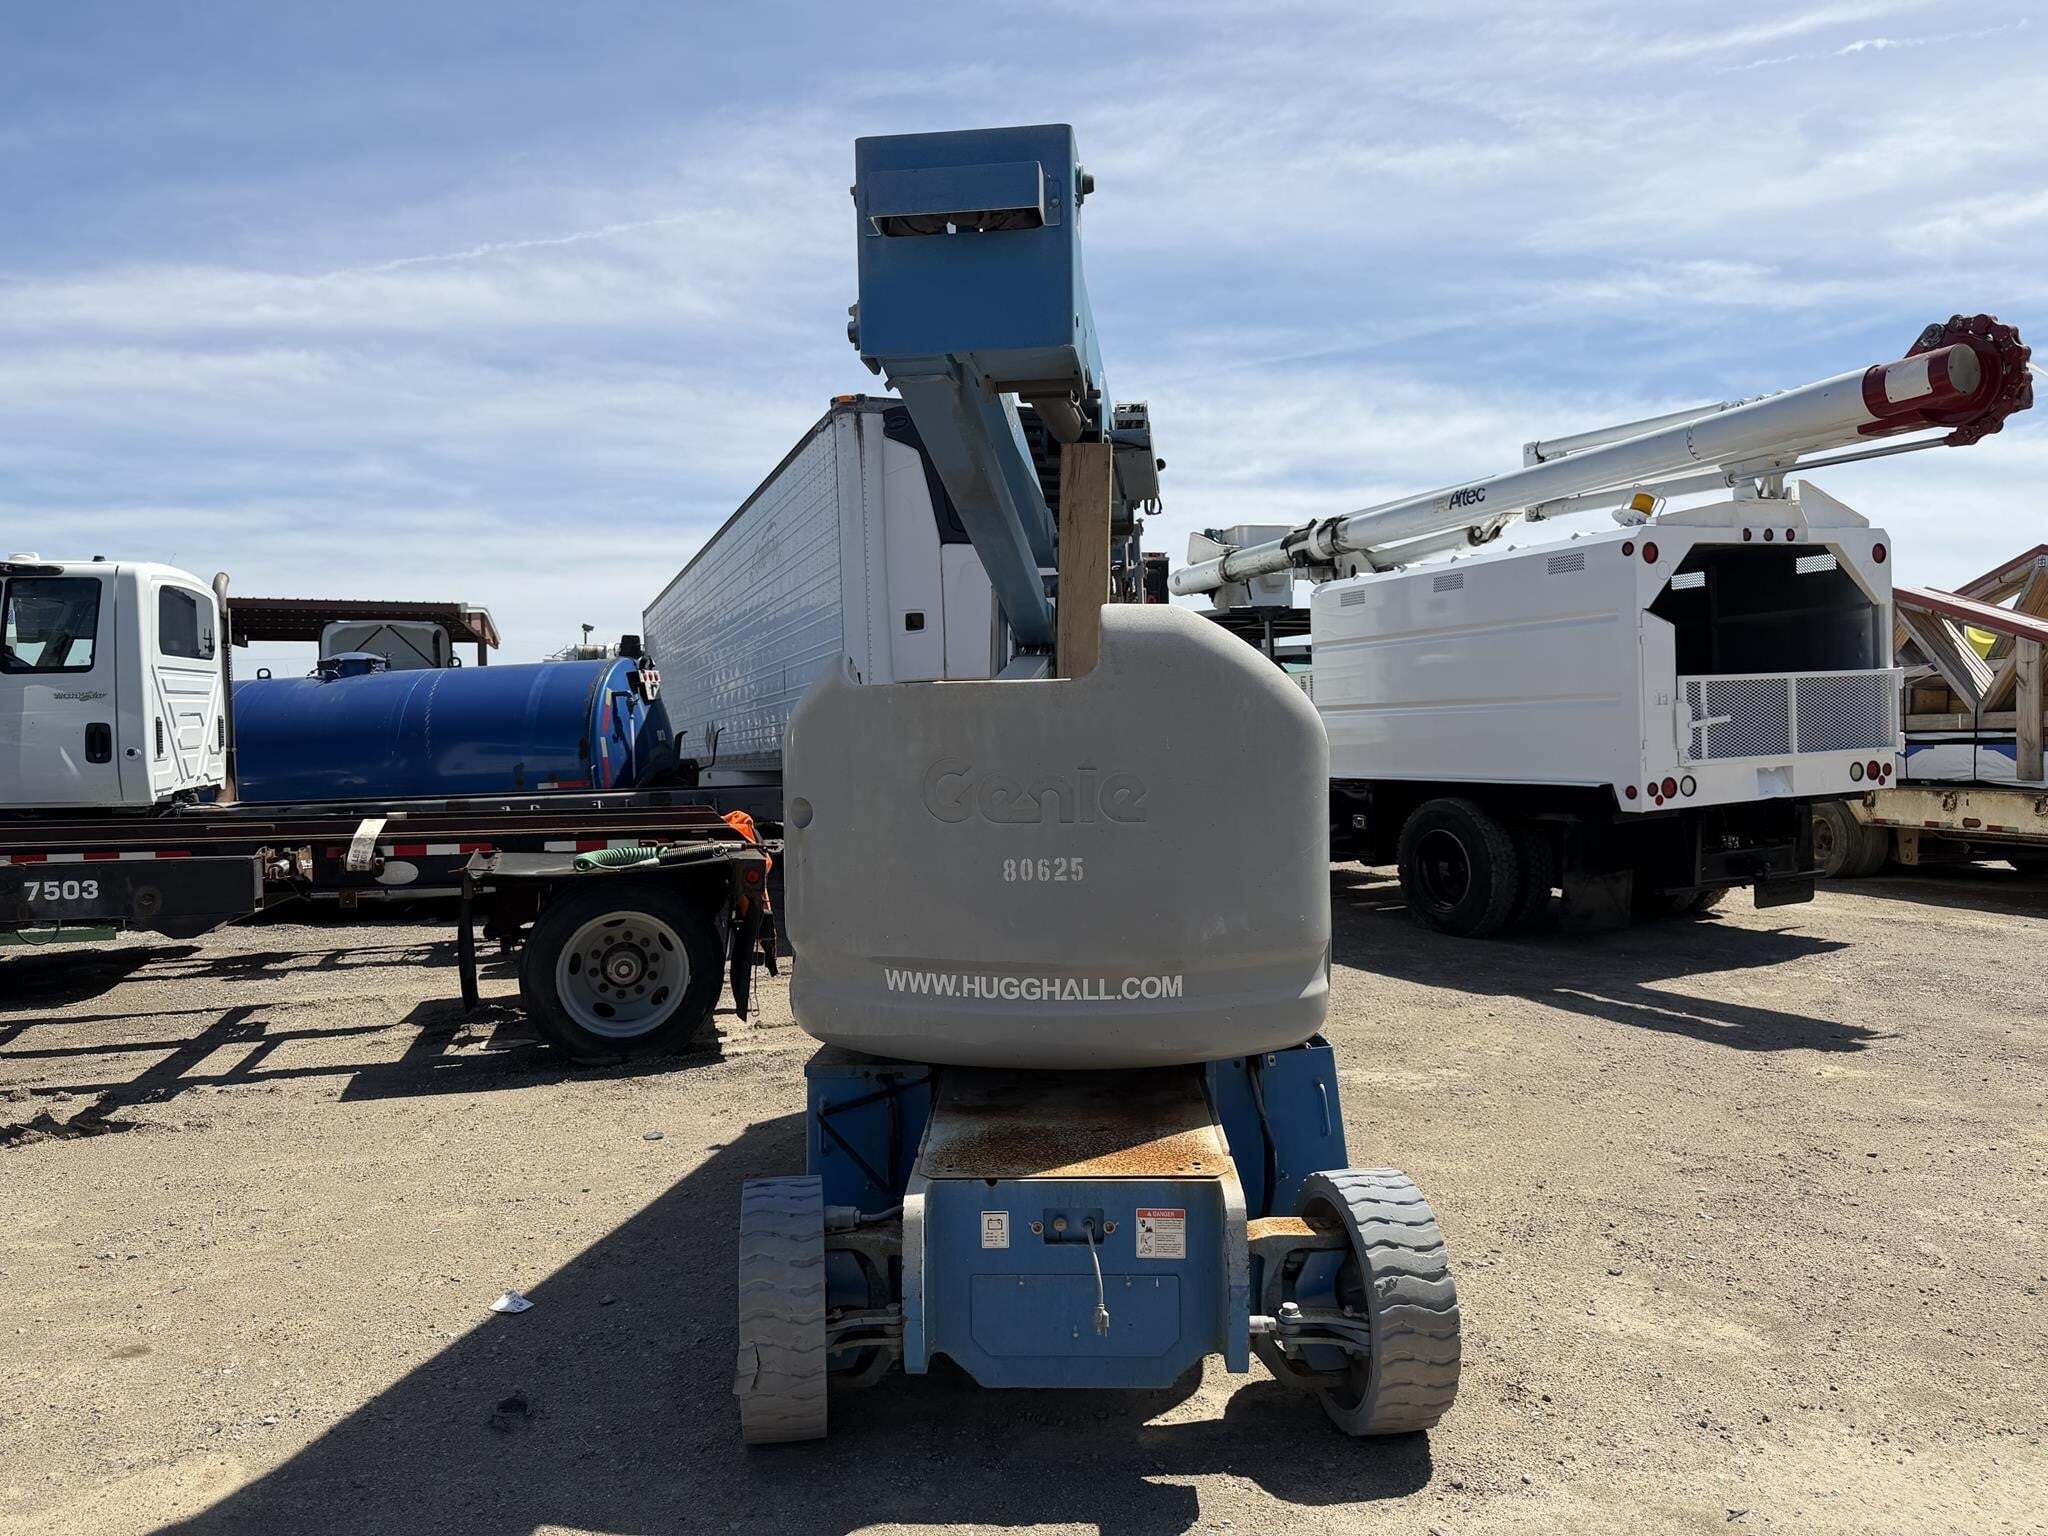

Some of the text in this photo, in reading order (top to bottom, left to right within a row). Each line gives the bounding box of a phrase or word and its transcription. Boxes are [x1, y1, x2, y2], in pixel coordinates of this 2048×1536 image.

[1449, 487, 1486, 510] Altec
[922, 757, 1149, 824] Genie
[1002, 857, 1085, 882] 80625
[23, 879, 99, 901] 7503
[884, 968, 1184, 1001] WWW.HUGGHALL.COM
